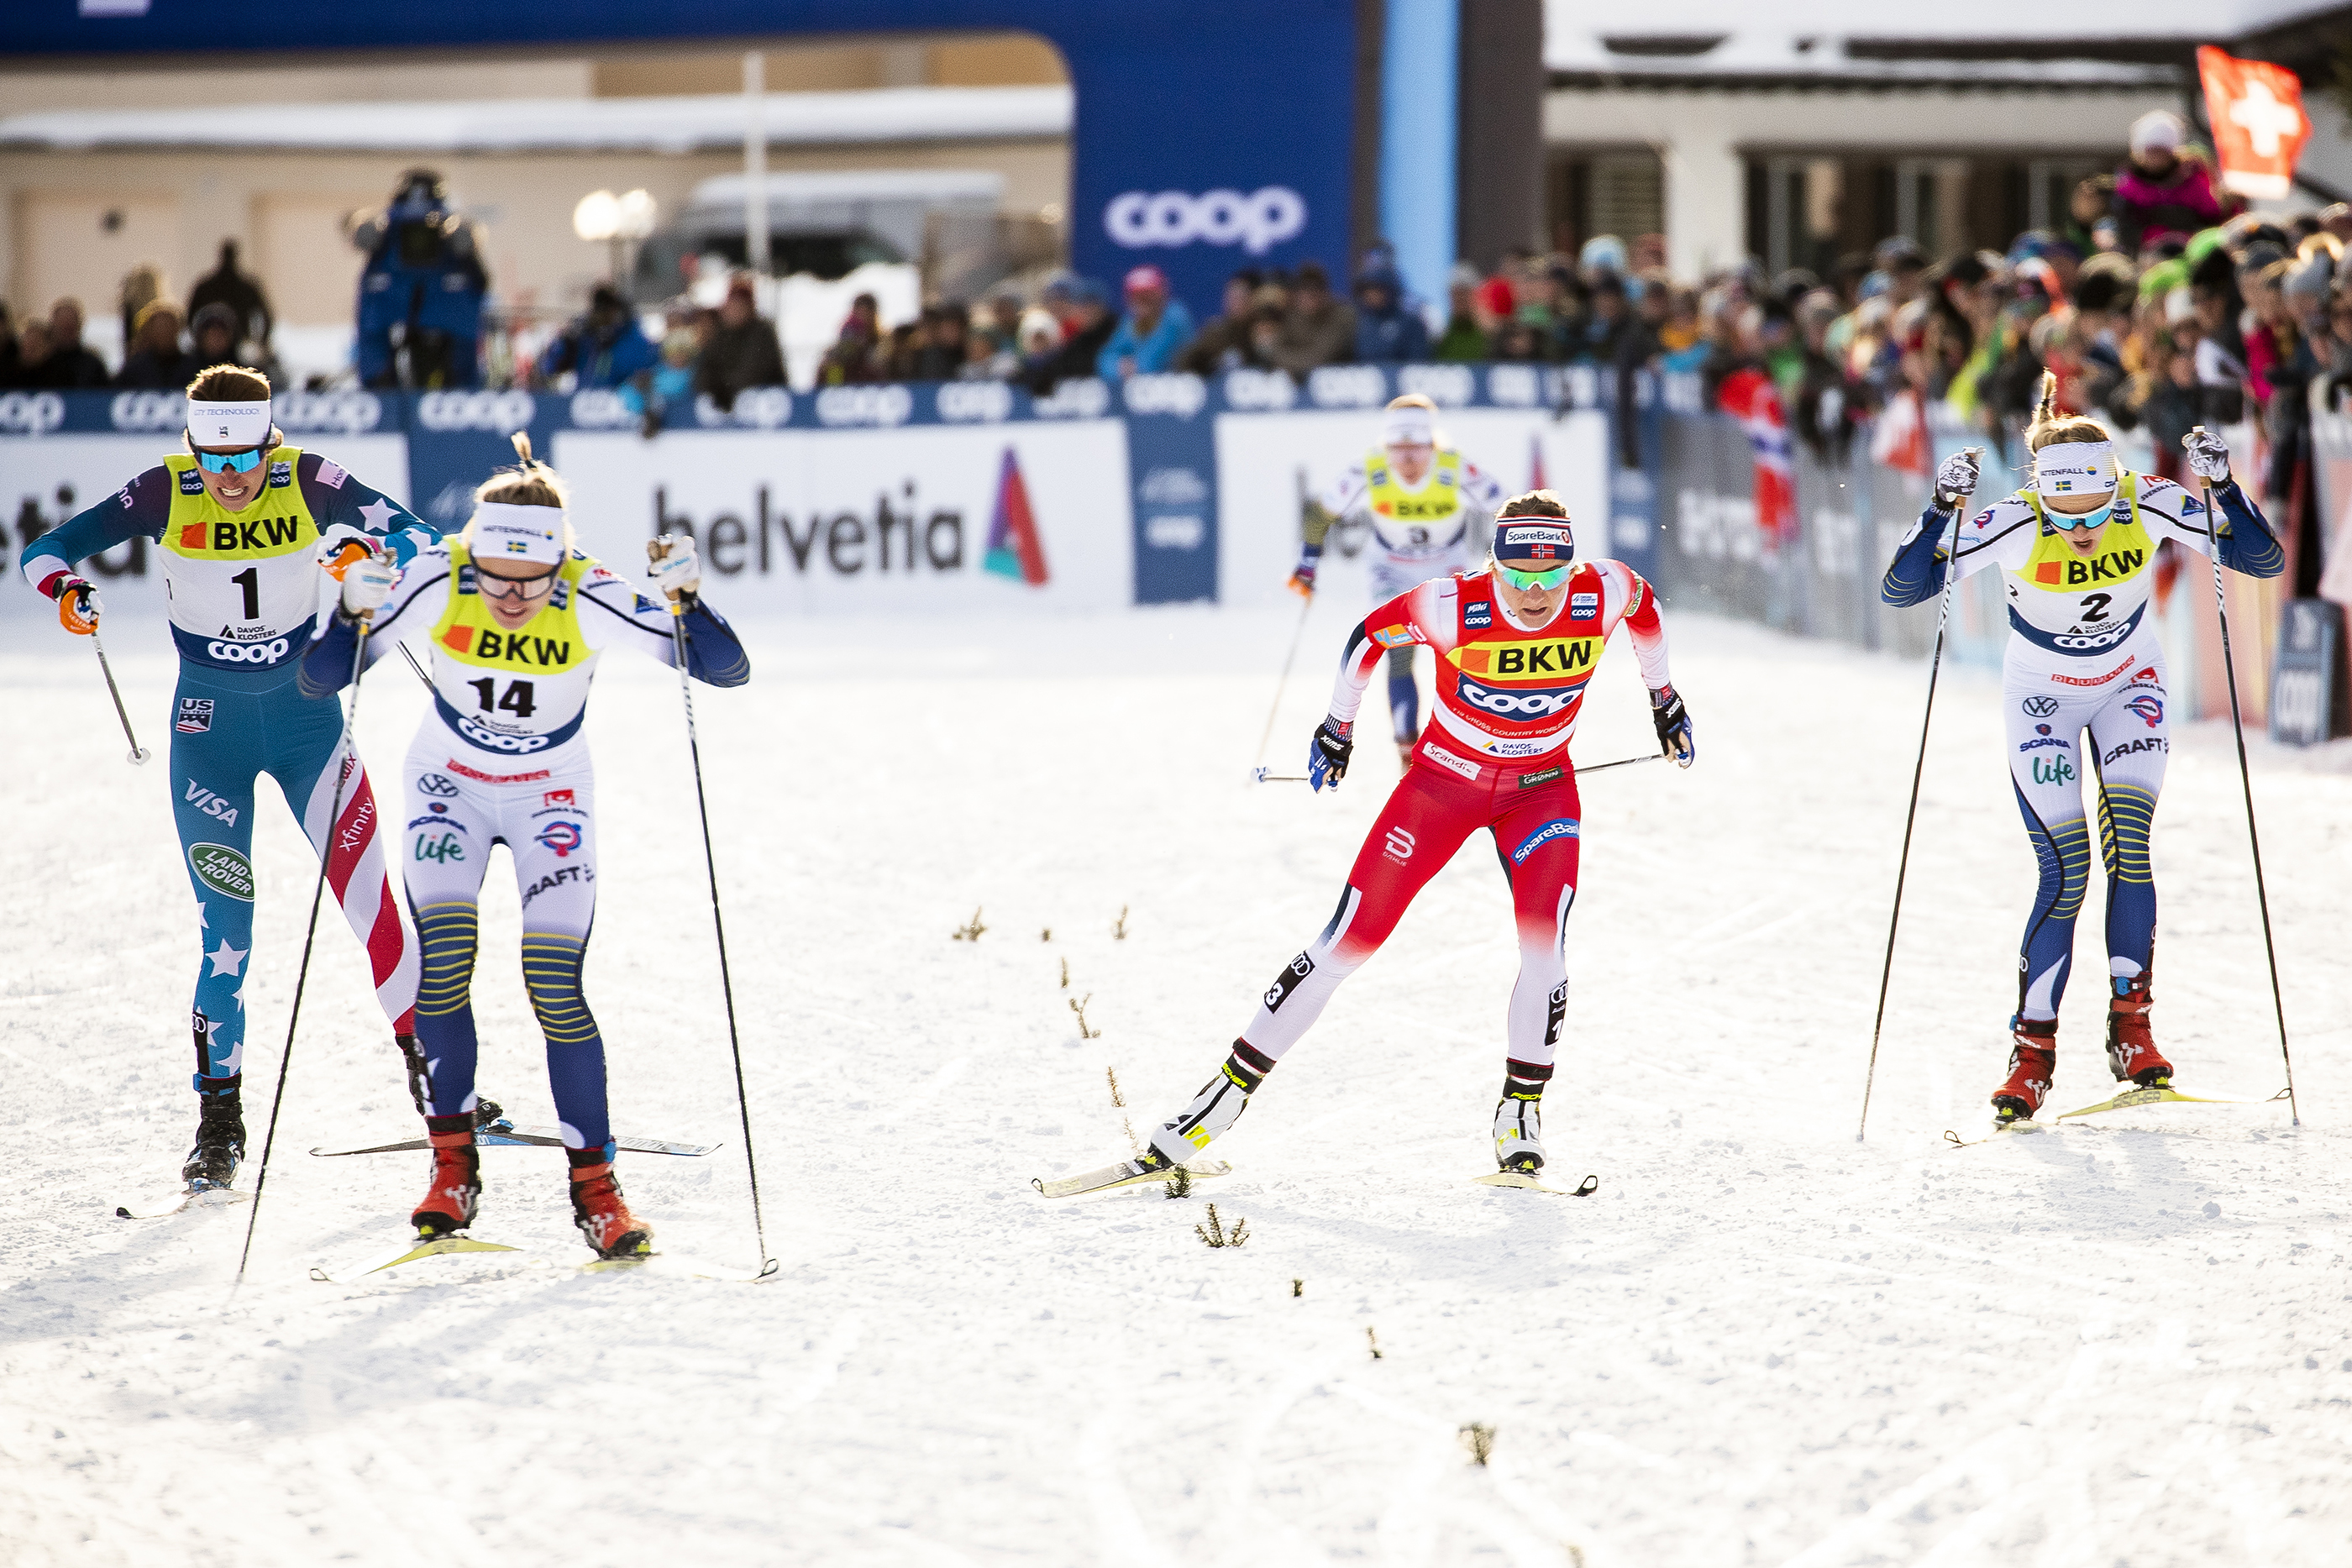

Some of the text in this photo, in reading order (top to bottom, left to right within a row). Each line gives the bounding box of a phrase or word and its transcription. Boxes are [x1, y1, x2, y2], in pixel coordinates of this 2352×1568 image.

[1102, 185, 1307, 254] coop
[213, 516, 297, 550] BKW
[650, 479, 966, 578] helvetia
[1508, 531, 1562, 542] SpareBank
[2067, 548, 2143, 585] BKW
[231, 568, 260, 620] 1
[2080, 593, 2113, 622] 2
[1464, 616, 1492, 625] coop
[1571, 609, 1596, 617] coop
[237, 625, 266, 633] DAVOS
[237, 629, 277, 641] KLOSTERS
[2053, 622, 2131, 649] coop
[207, 638, 289, 664] coop
[476, 630, 570, 666] BKW
[1499, 641, 1592, 674] BKW
[181, 700, 213, 711] US
[467, 677, 537, 718] 14
[1462, 684, 1583, 715] coop
[458, 717, 549, 753] coop
[1492, 728, 1533, 737] COUNTRY
[2019, 737, 2071, 752] SCANIA
[2104, 737, 2162, 765] CRAFT
[2033, 753, 2076, 786] life
[183, 778, 239, 828] VISA
[339, 797, 375, 852] xfinity
[415, 832, 465, 863] life
[202, 863, 252, 894] ROVER
[204, 851, 249, 877] LAND
